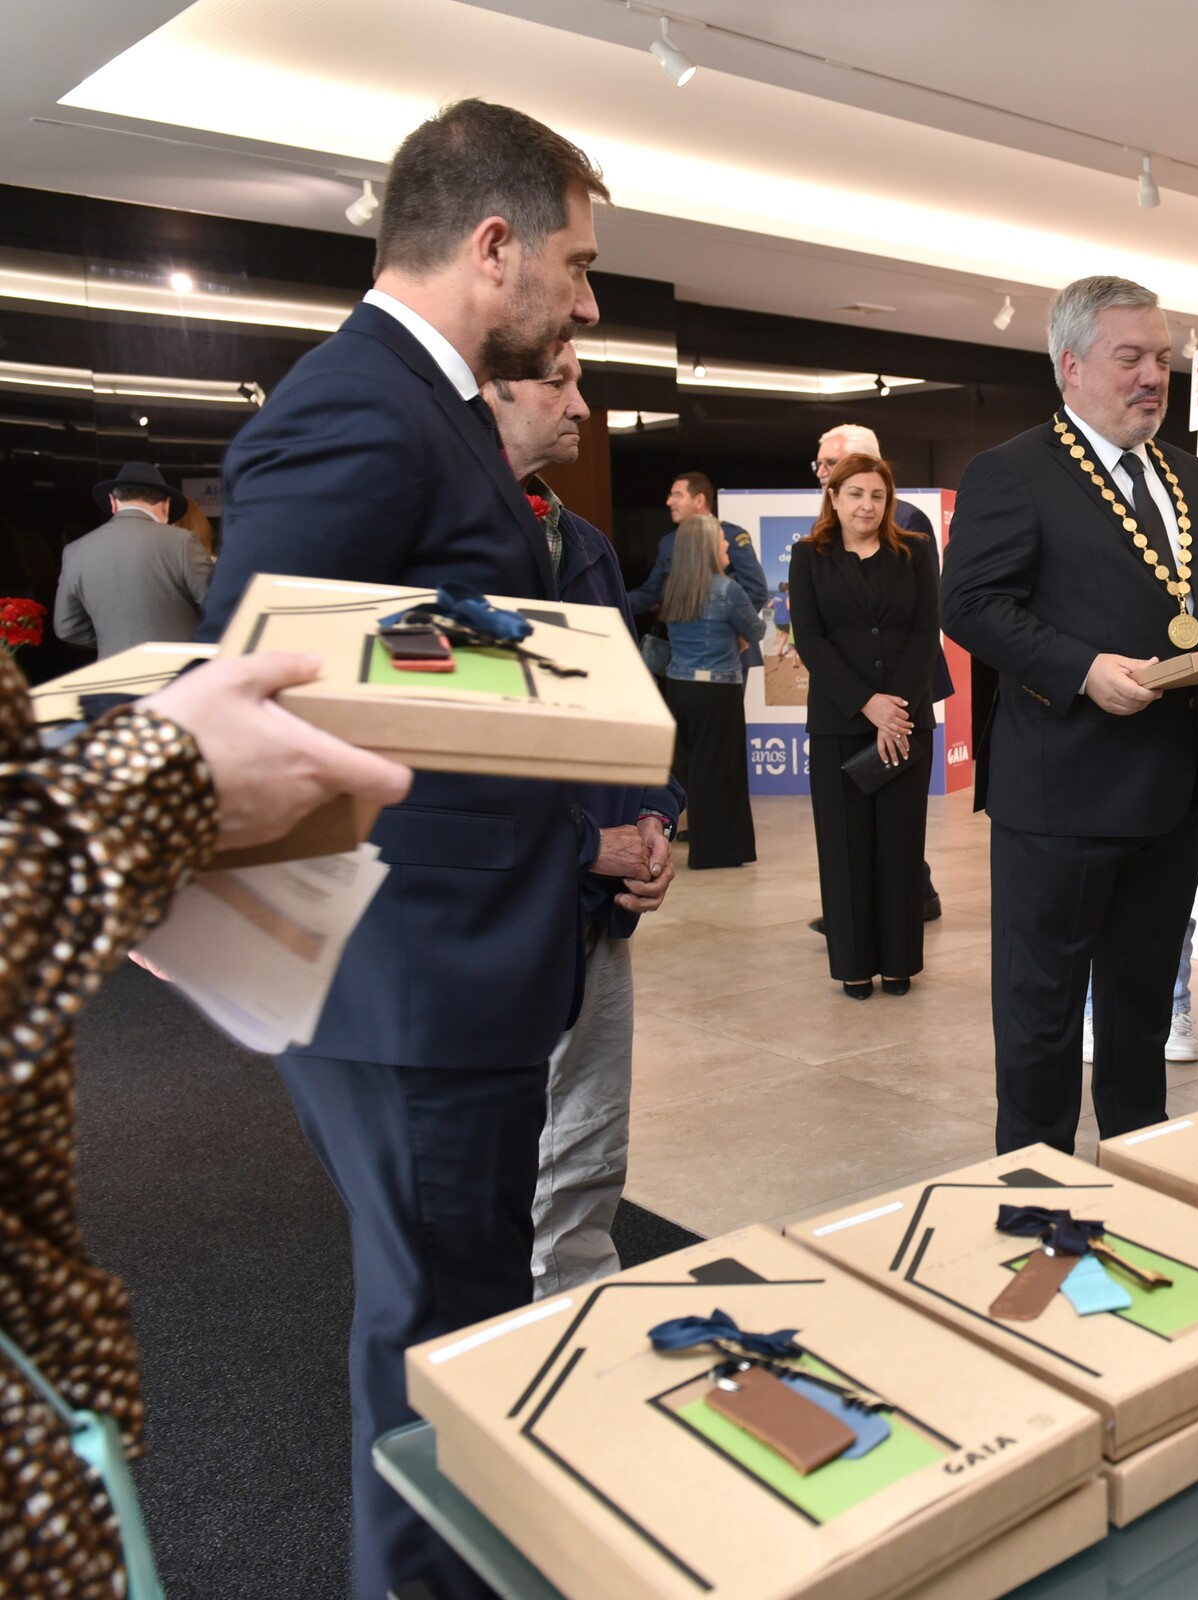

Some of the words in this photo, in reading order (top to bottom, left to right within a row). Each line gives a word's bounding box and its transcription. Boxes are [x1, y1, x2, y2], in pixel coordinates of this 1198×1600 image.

[751, 737, 786, 775] 10
[751, 749, 786, 763] anos
[947, 745, 969, 765] GAIA
[943, 1436, 1017, 1475] GAIA
